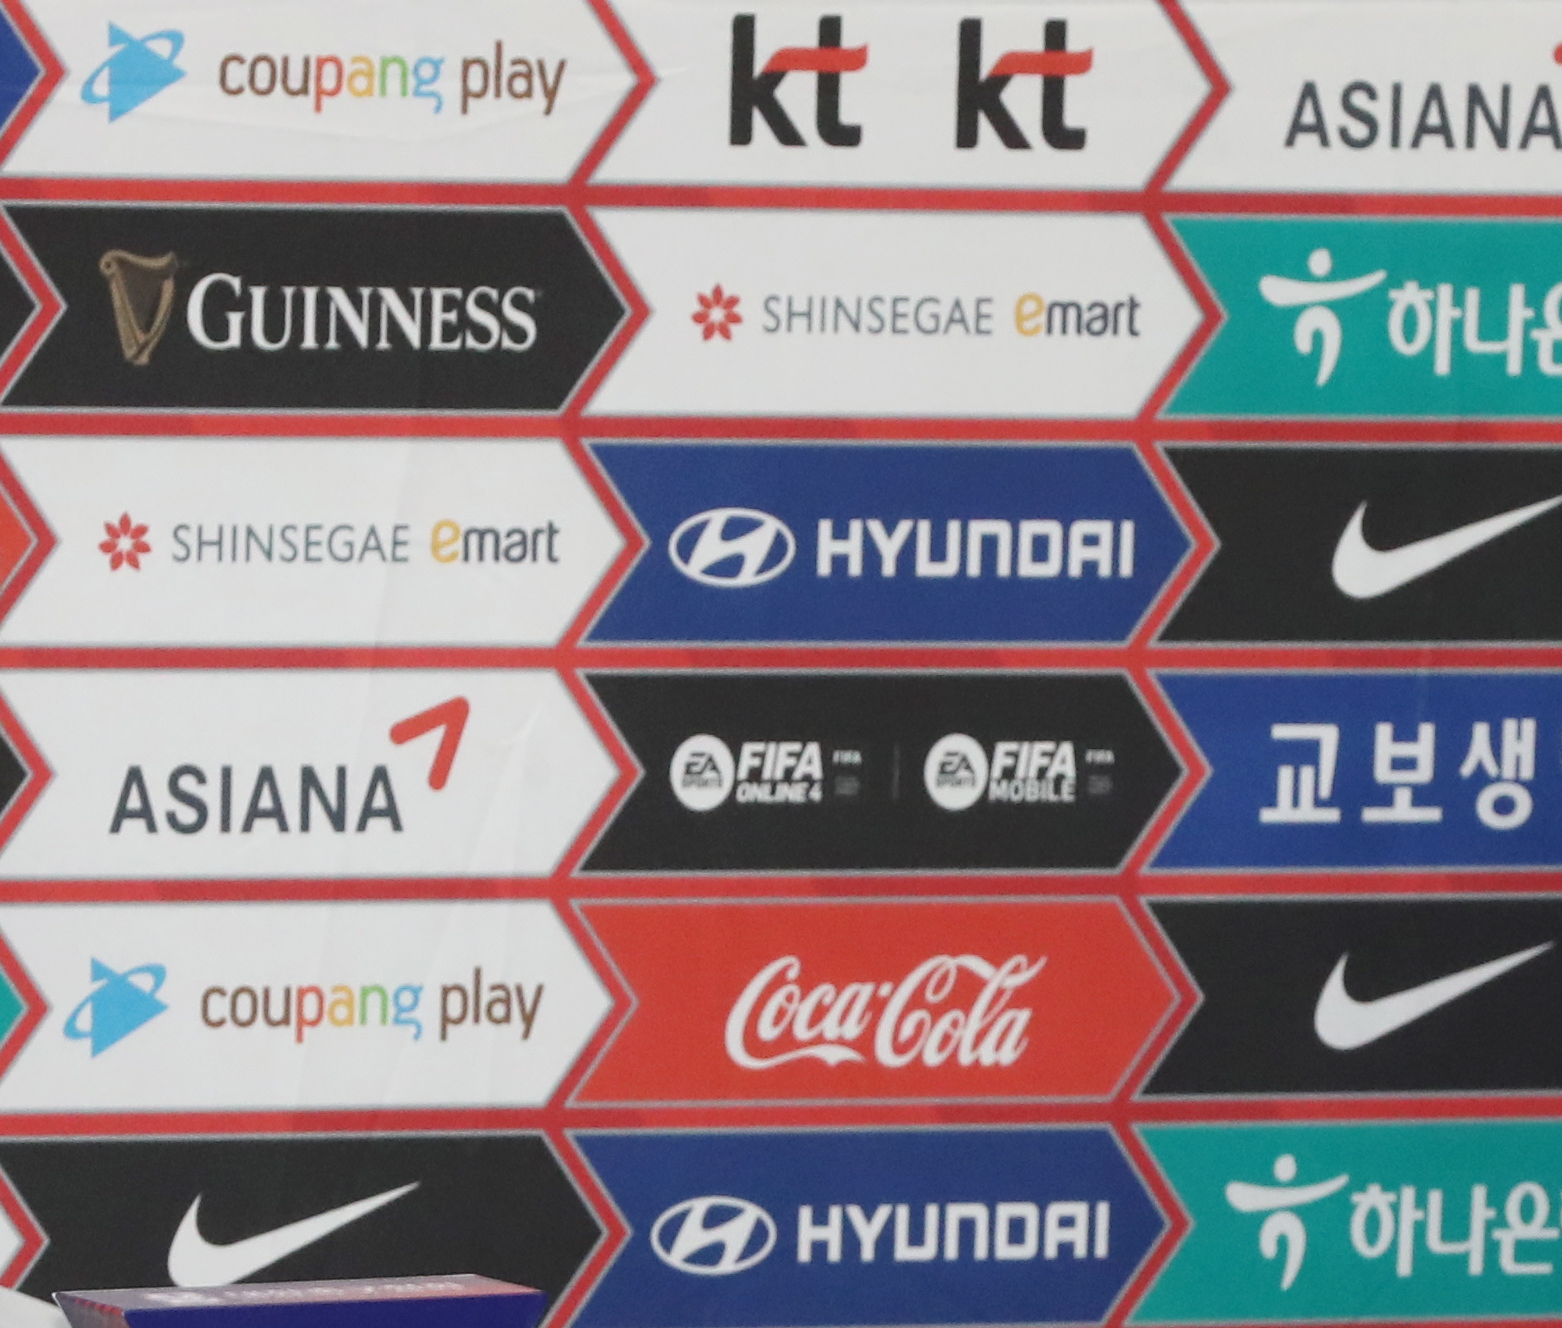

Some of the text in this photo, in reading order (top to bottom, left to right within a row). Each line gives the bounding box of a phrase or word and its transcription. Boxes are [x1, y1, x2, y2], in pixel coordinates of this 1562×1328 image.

[219, 40, 566, 116] coupang play
[730, 14, 1092, 150] kt kt
[1285, 81, 1562, 150] ASIANA
[187, 273, 536, 351] GUINNESS
[764, 293, 1140, 337] SHINSEGAE emart
[173, 520, 559, 563] SHINSEGAE emart
[817, 519, 1134, 577] HYUNDAI
[738, 741, 823, 780] FIFA
[988, 780, 1076, 803] MOBILE
[990, 741, 1076, 780] FIFA
[110, 764, 403, 835] ASIANA
[736, 781, 803, 804] ONLINE
[201, 967, 544, 1044] coupang play
[725, 955, 1046, 1070] Coca-Cola
[798, 1201, 1109, 1263] HYUNDAI
